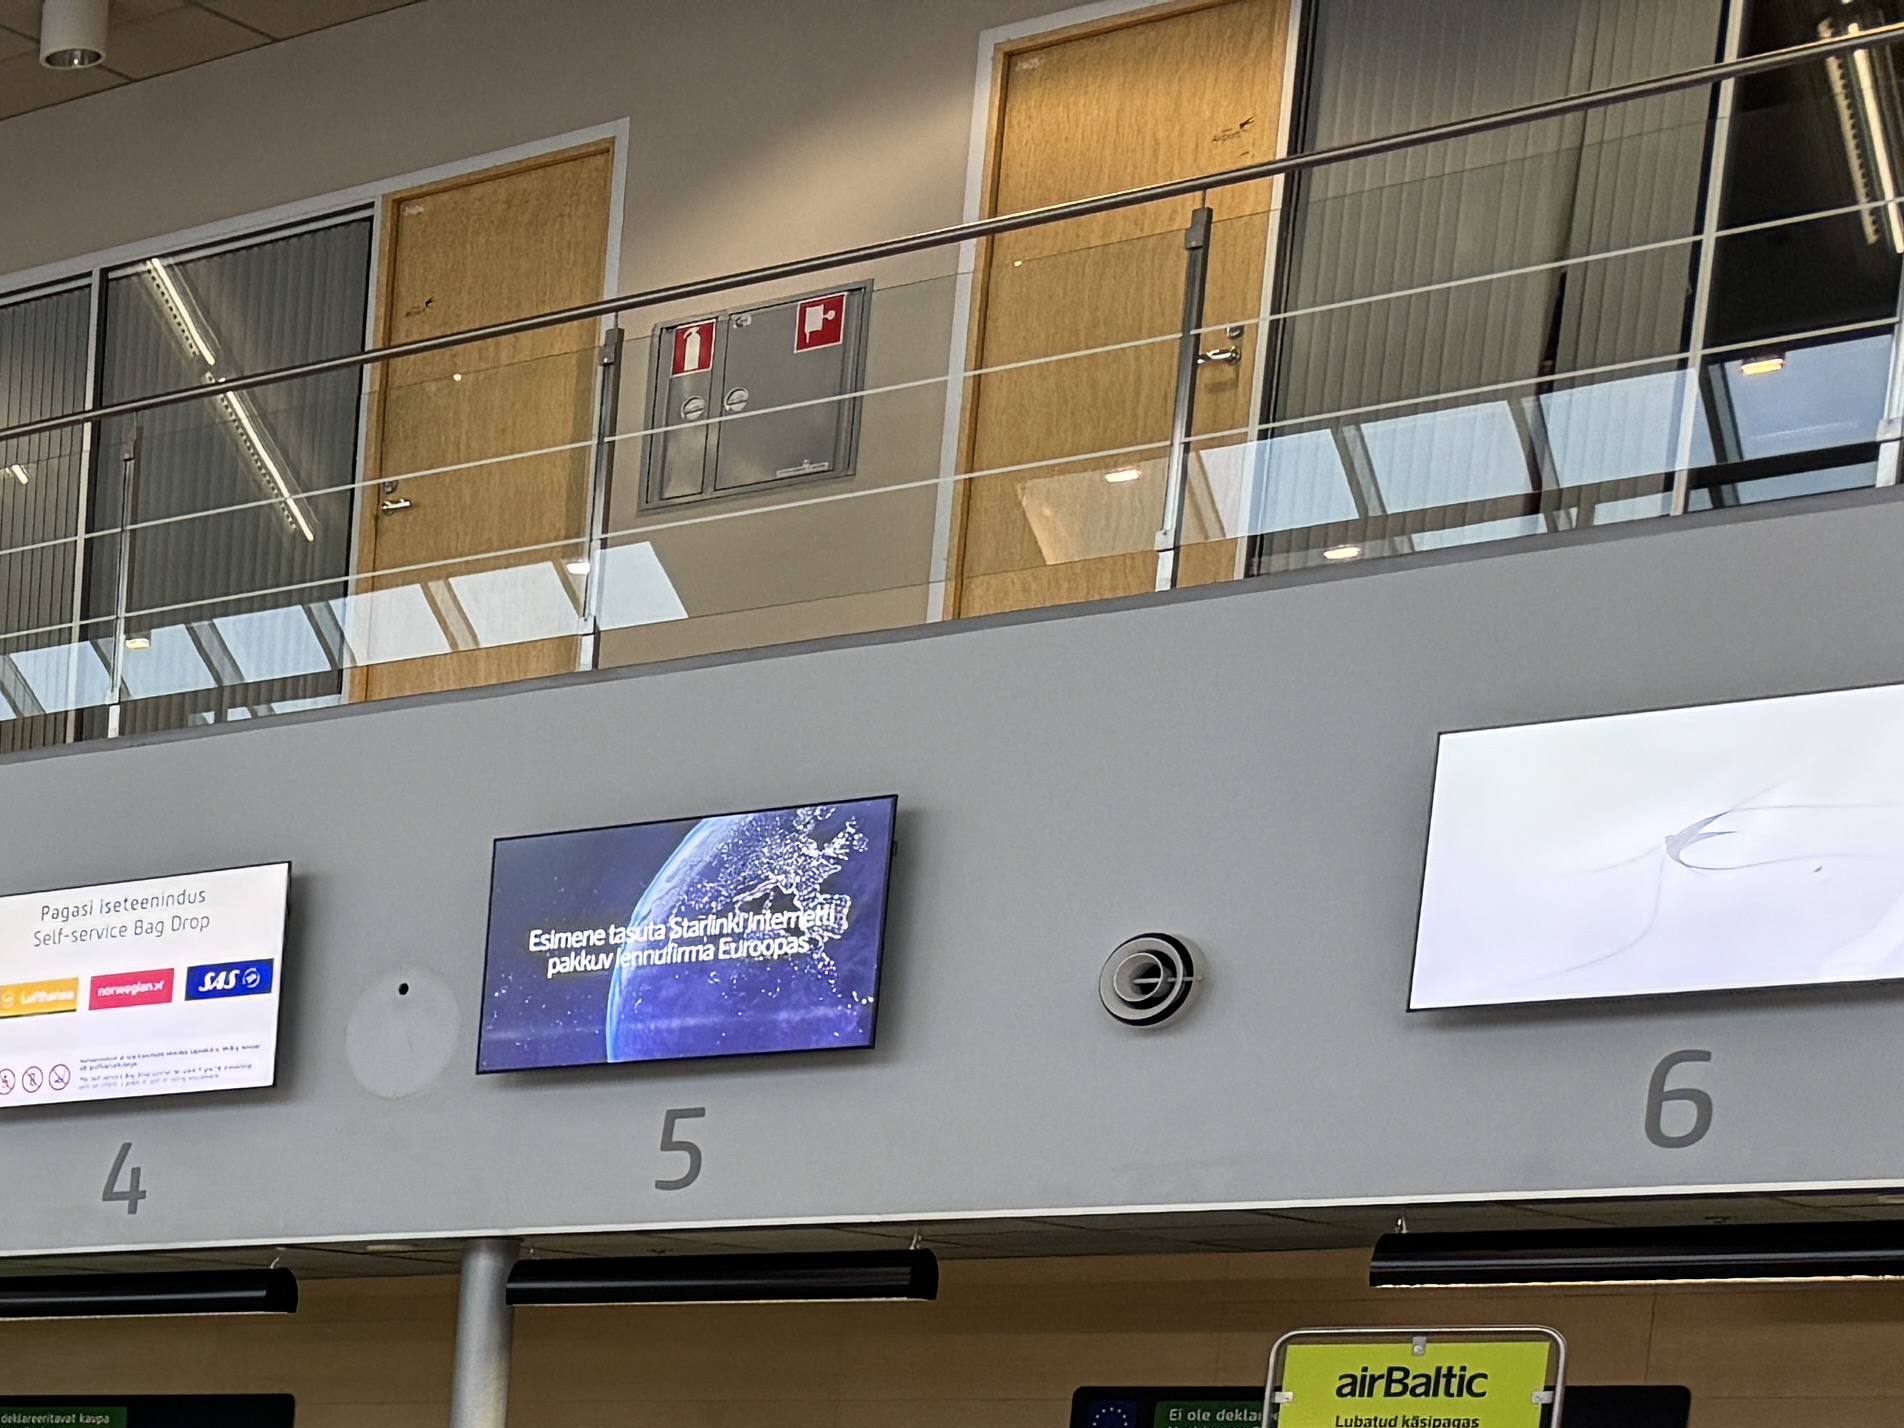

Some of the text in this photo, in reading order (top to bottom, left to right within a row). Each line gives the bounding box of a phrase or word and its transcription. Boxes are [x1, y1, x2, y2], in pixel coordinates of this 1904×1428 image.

[41, 889, 206, 922] Pagasi iseteenindus
[33, 914, 211, 947] Self-service Bag Drop
[529, 928, 605, 952] Esimene
[609, 923, 666, 944] tasuta
[547, 937, 810, 978] pakkuv lennufirma Euroopas
[198, 969, 240, 992] SAS
[1644, 1048, 1714, 1149] 6
[654, 1107, 706, 1190] 5
[102, 1142, 147, 1214] 4
[1335, 1365, 1489, 1398] airBaltic
[1169, 1408, 1211, 1422] Ei ole
[1335, 1415, 1398, 1428] Lubatud
